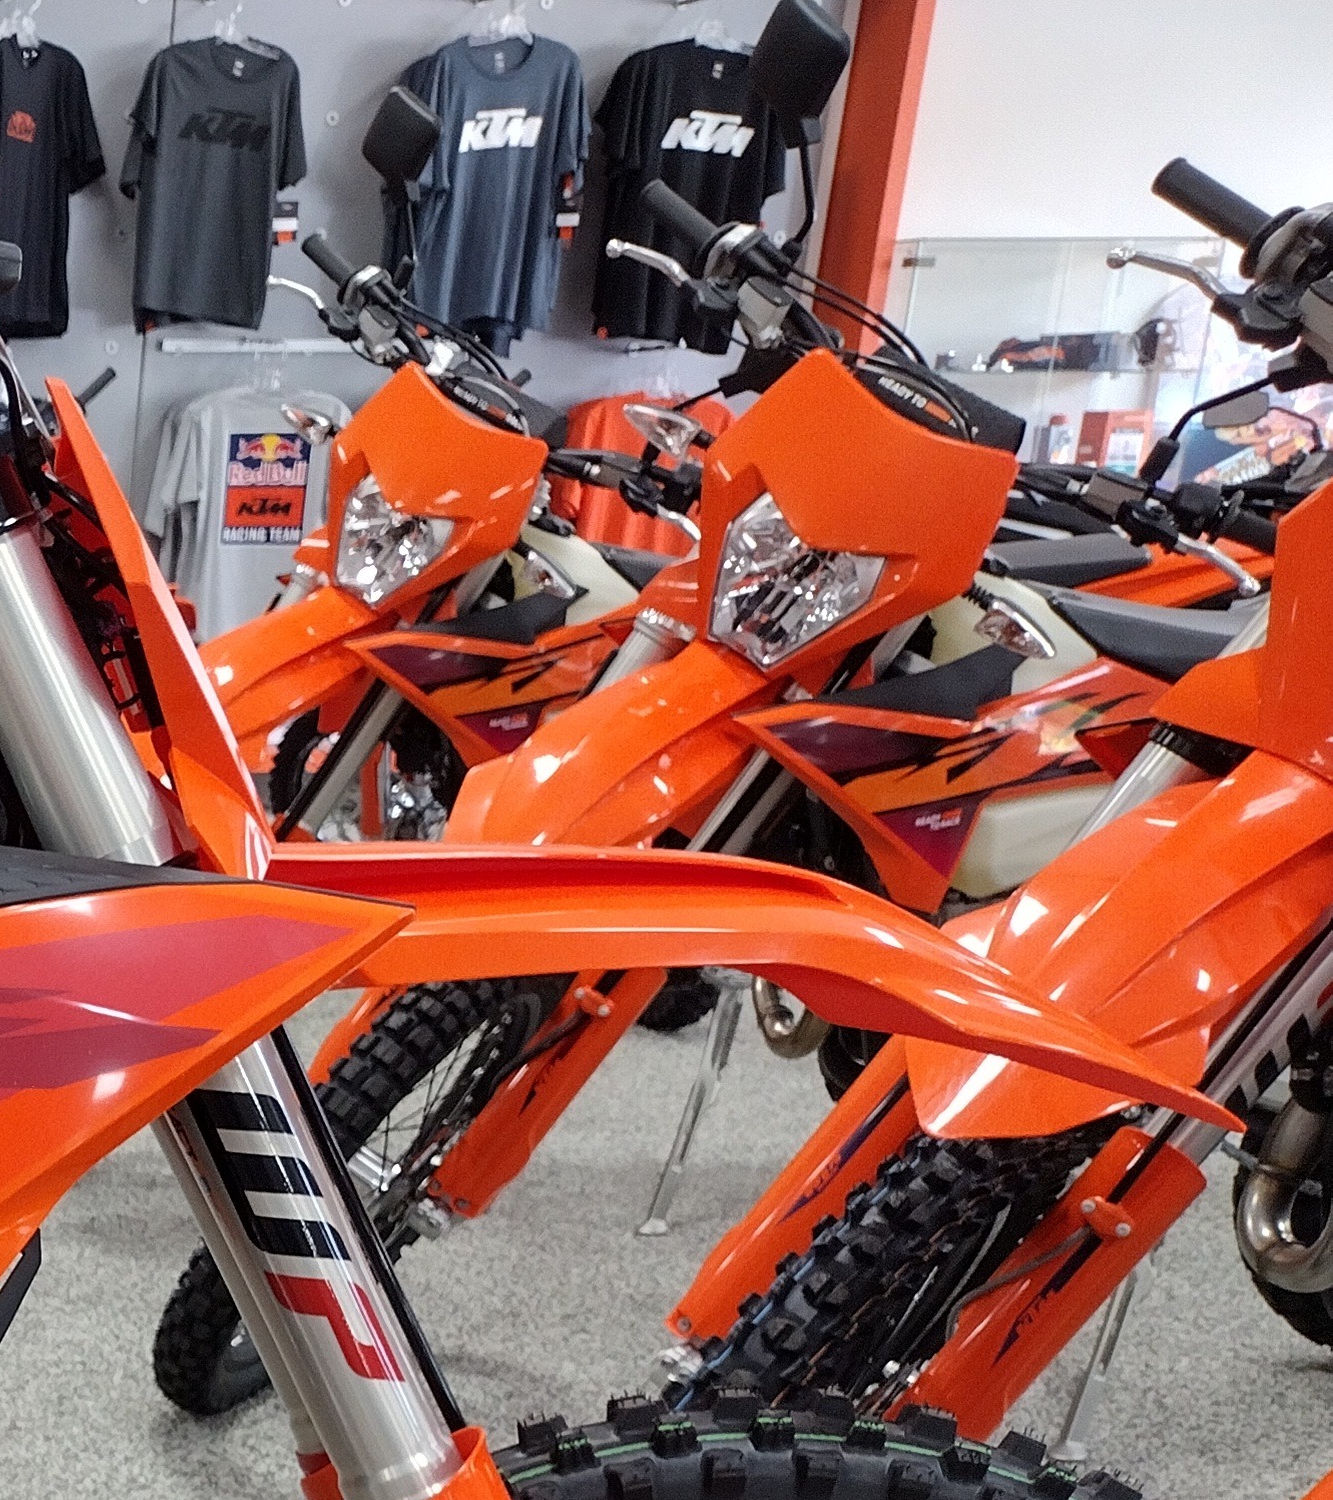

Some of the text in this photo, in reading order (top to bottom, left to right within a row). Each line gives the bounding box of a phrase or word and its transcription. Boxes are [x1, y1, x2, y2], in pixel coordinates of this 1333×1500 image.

[178, 106, 271, 150] KTM
[458, 107, 544, 153] KTM
[661, 109, 755, 158] KTM
[237, 498, 292, 516] KTM
[188, 1088, 405, 1383] WP
